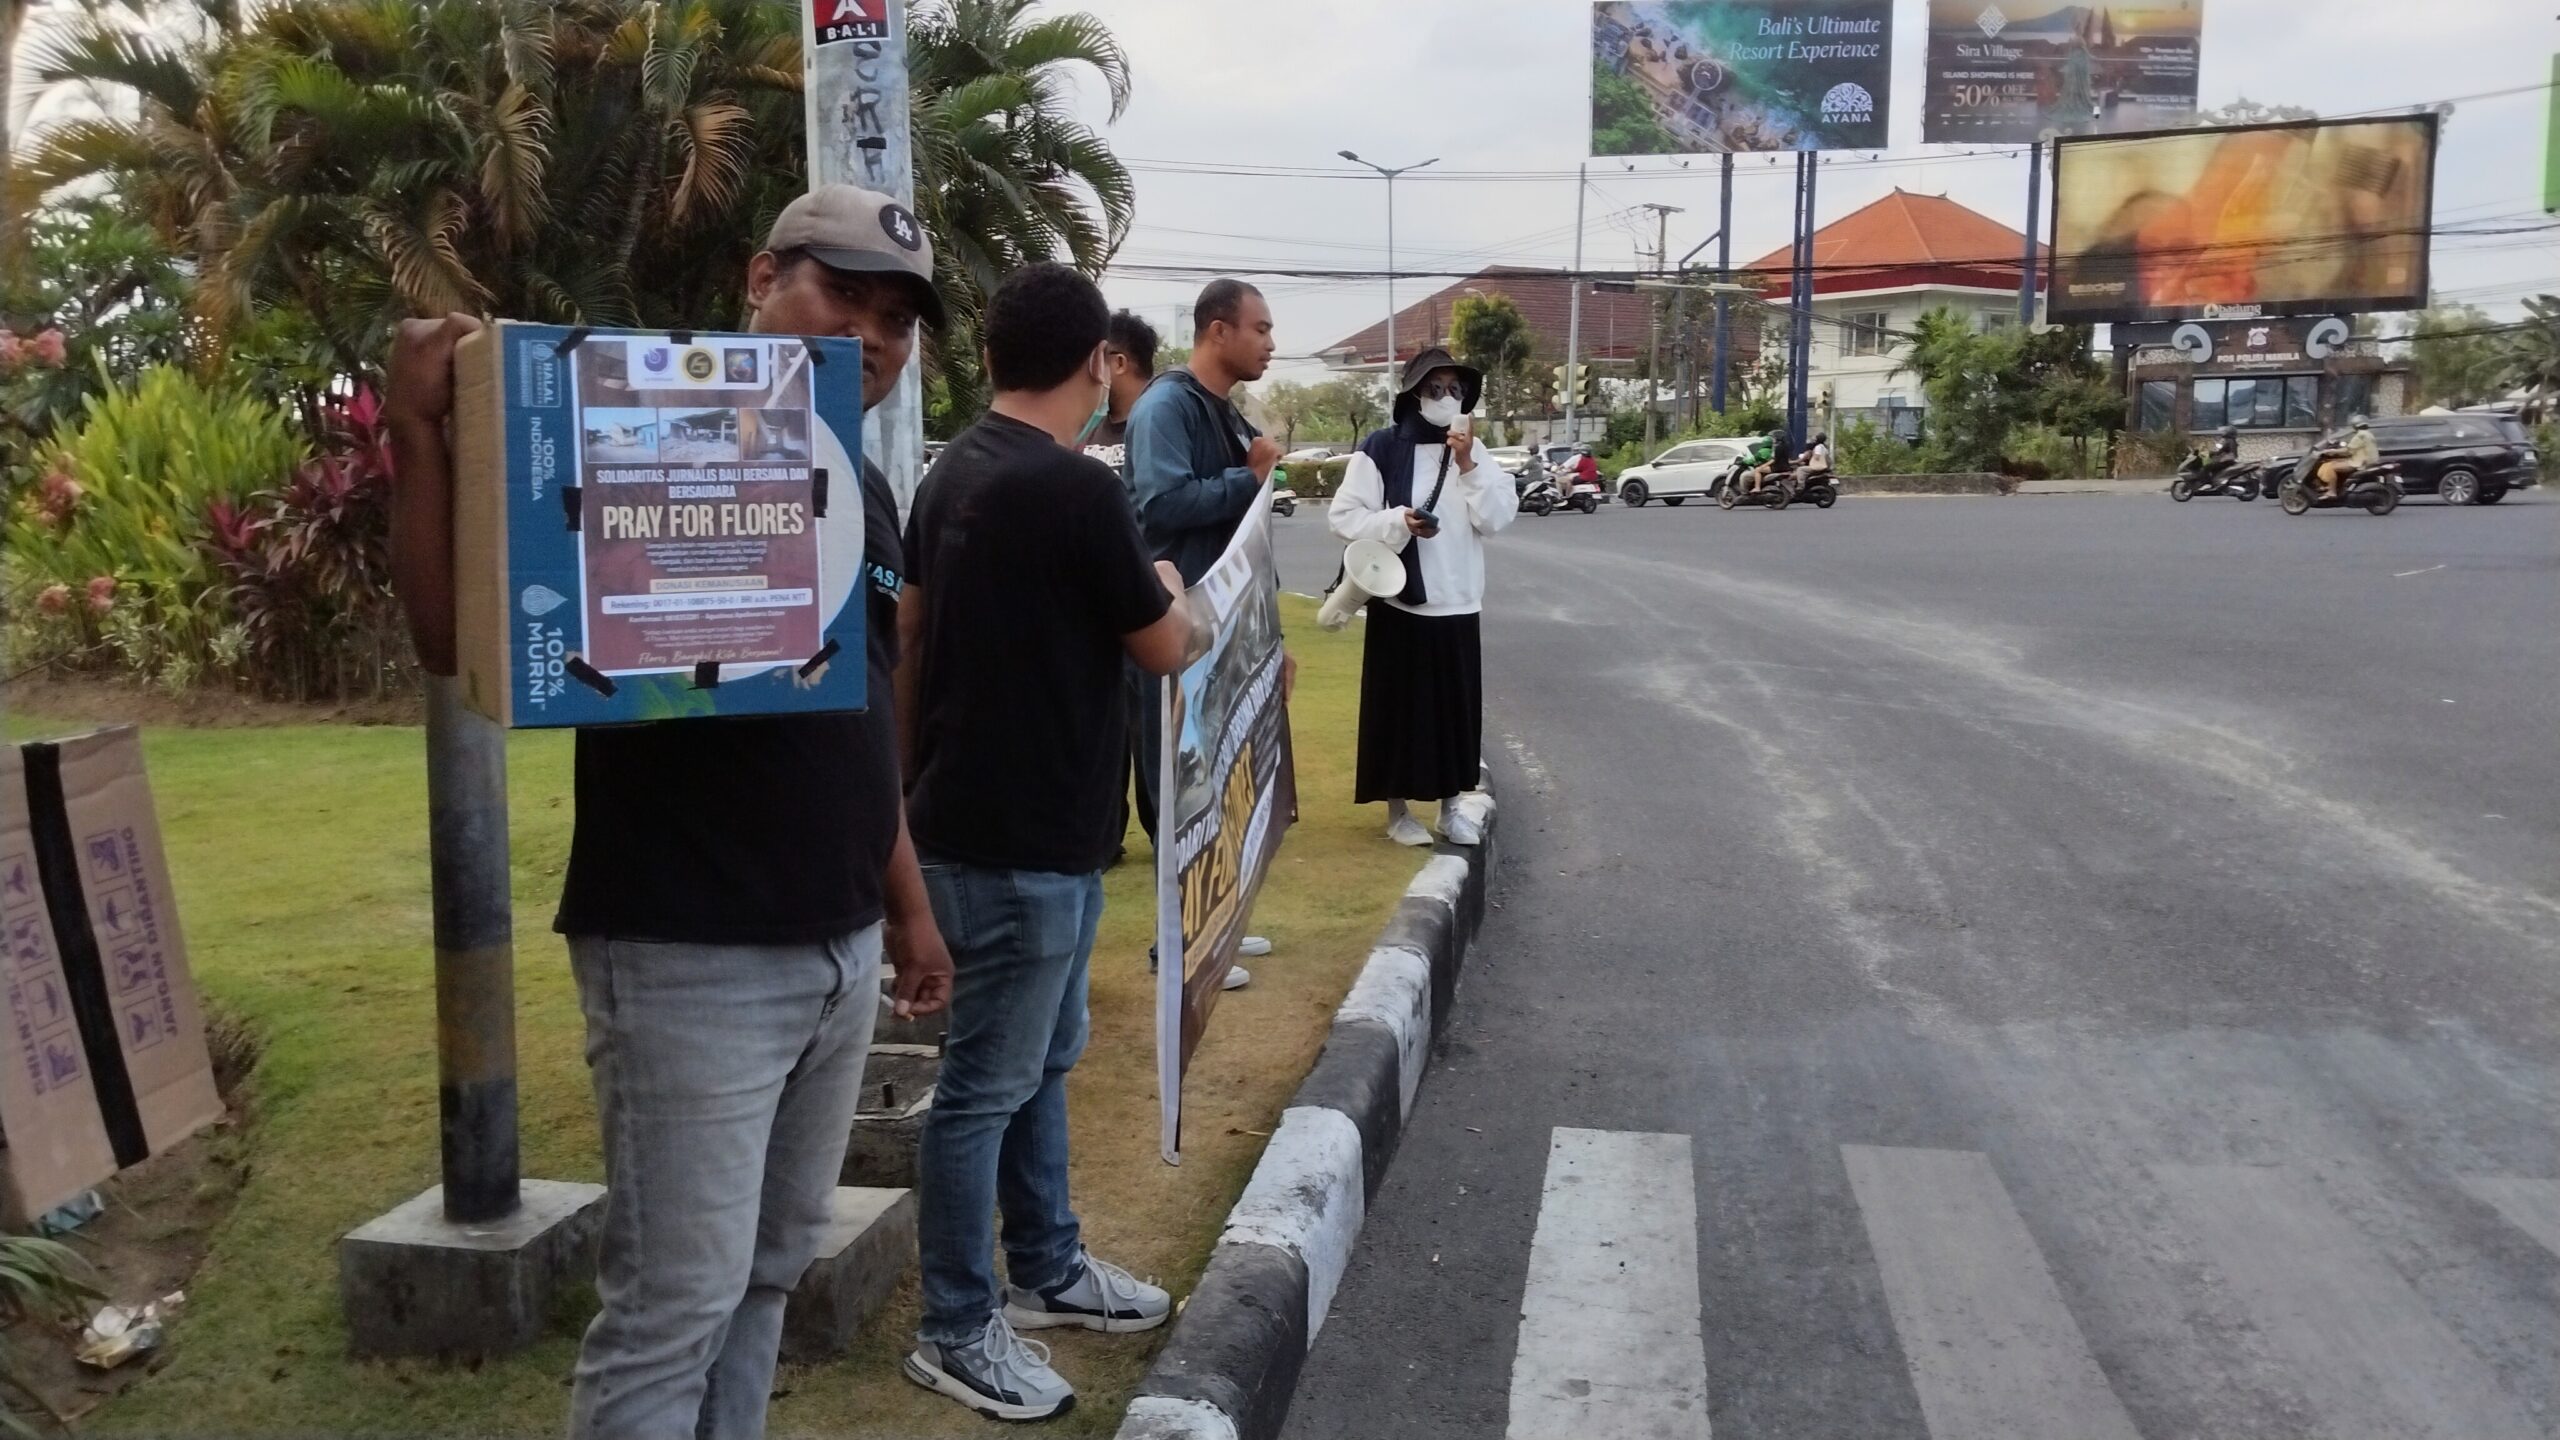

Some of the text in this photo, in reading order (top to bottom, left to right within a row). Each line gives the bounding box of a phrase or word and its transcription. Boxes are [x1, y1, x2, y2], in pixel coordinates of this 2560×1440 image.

[1758, 16, 1881, 35] Bali's Ultimate
[1730, 41, 1880, 63] Resort Experience
[1956, 44, 2023, 60] Sira Village
[1953, 84, 2000, 107] 50%
[1821, 113, 1872, 124] AYANA
[543, 362, 554, 404] HALAL
[530, 416, 544, 501] INDONESIA
[542, 436, 556, 481] 100%
[596, 468, 809, 483] SOLIDARITAS JURNALIS BALI BERSAMA DAN
[668, 485, 737, 499] BERSAUDARA
[602, 502, 805, 539] PRAY FOR FLORES
[546, 626, 566, 697] 100%
[120, 826, 179, 1038] JANGAN DIBANTING
